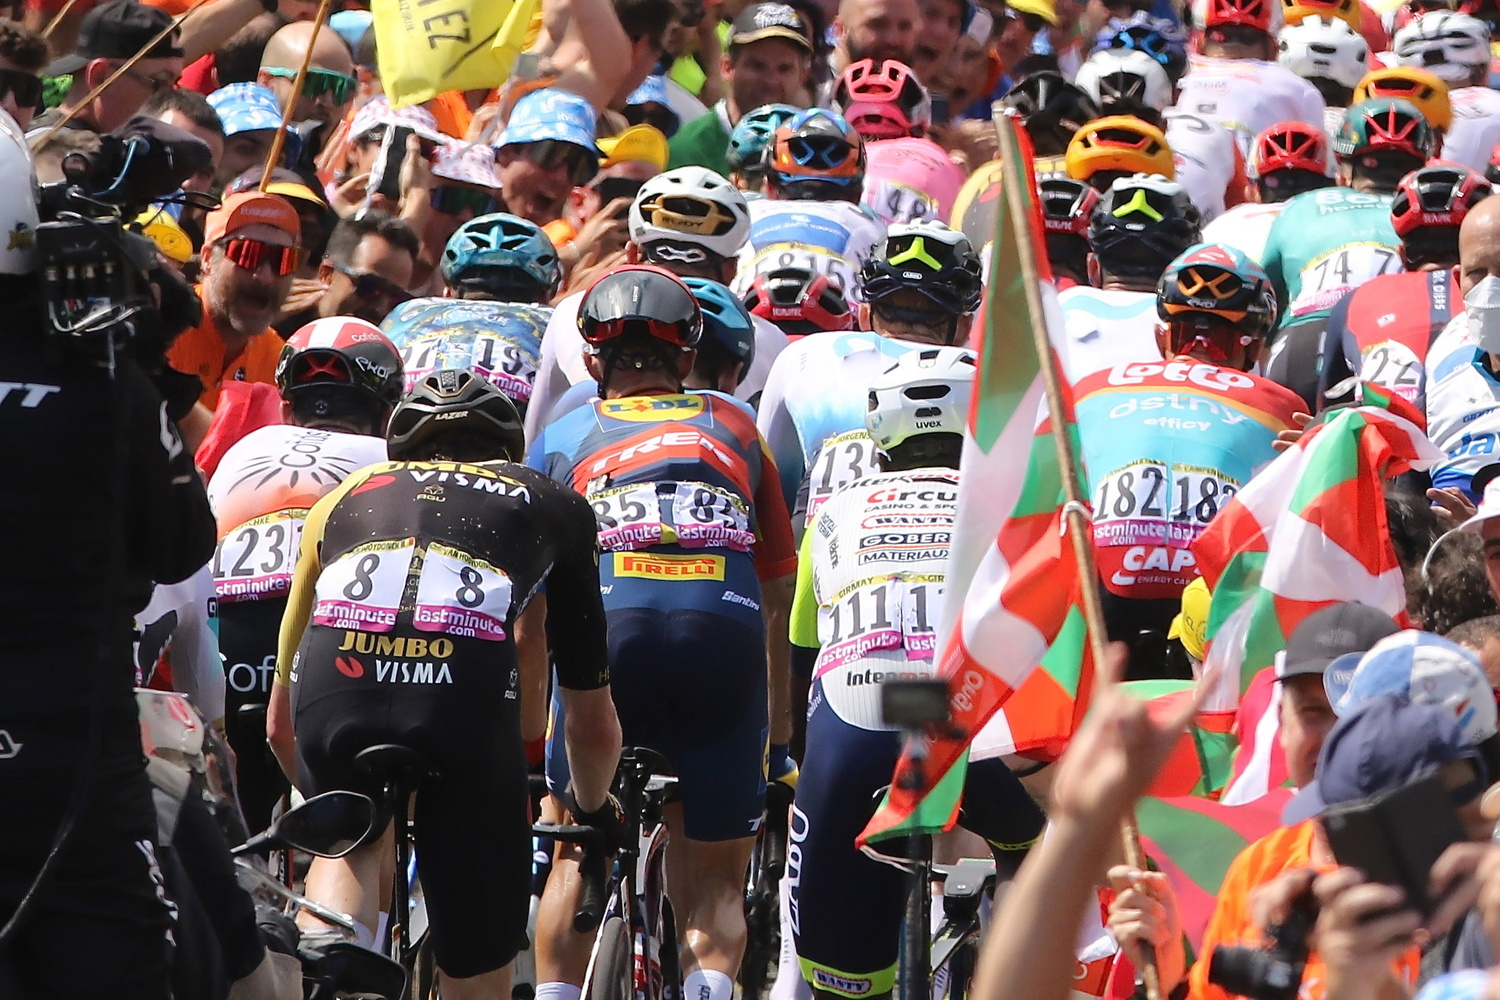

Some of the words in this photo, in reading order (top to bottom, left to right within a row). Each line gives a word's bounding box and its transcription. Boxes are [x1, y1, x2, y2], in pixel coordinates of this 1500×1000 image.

[423, 9, 471, 49] EZ
[434, 410, 469, 420] LAZER
[1109, 393, 1249, 426] dstny
[915, 420, 942, 429] uvex
[1142, 417, 1212, 431] efficy
[409, 470, 531, 504] VISMA
[867, 488, 957, 504] Circu
[1094, 466, 1163, 521] 182
[864, 503, 915, 513] CASINO
[862, 534, 950, 547] GOBER
[623, 556, 717, 575] PIRELLI
[1122, 546, 1200, 573] CAP
[215, 578, 288, 597] stminute
[342, 552, 380, 601] 8
[455, 566, 486, 608] 8
[838, 577, 875, 599] GIRMAY
[721, 590, 760, 612] Santini
[333, 616, 361, 630] .com
[414, 605, 504, 635] lastminute
[827, 585, 893, 648] 111
[445, 624, 476, 638] .com
[338, 631, 454, 658] JUMBO
[818, 633, 899, 669] lastminute
[841, 648, 868, 665] .com
[375, 659, 454, 684] VISMA
[816, 971, 865, 991] WANTY
